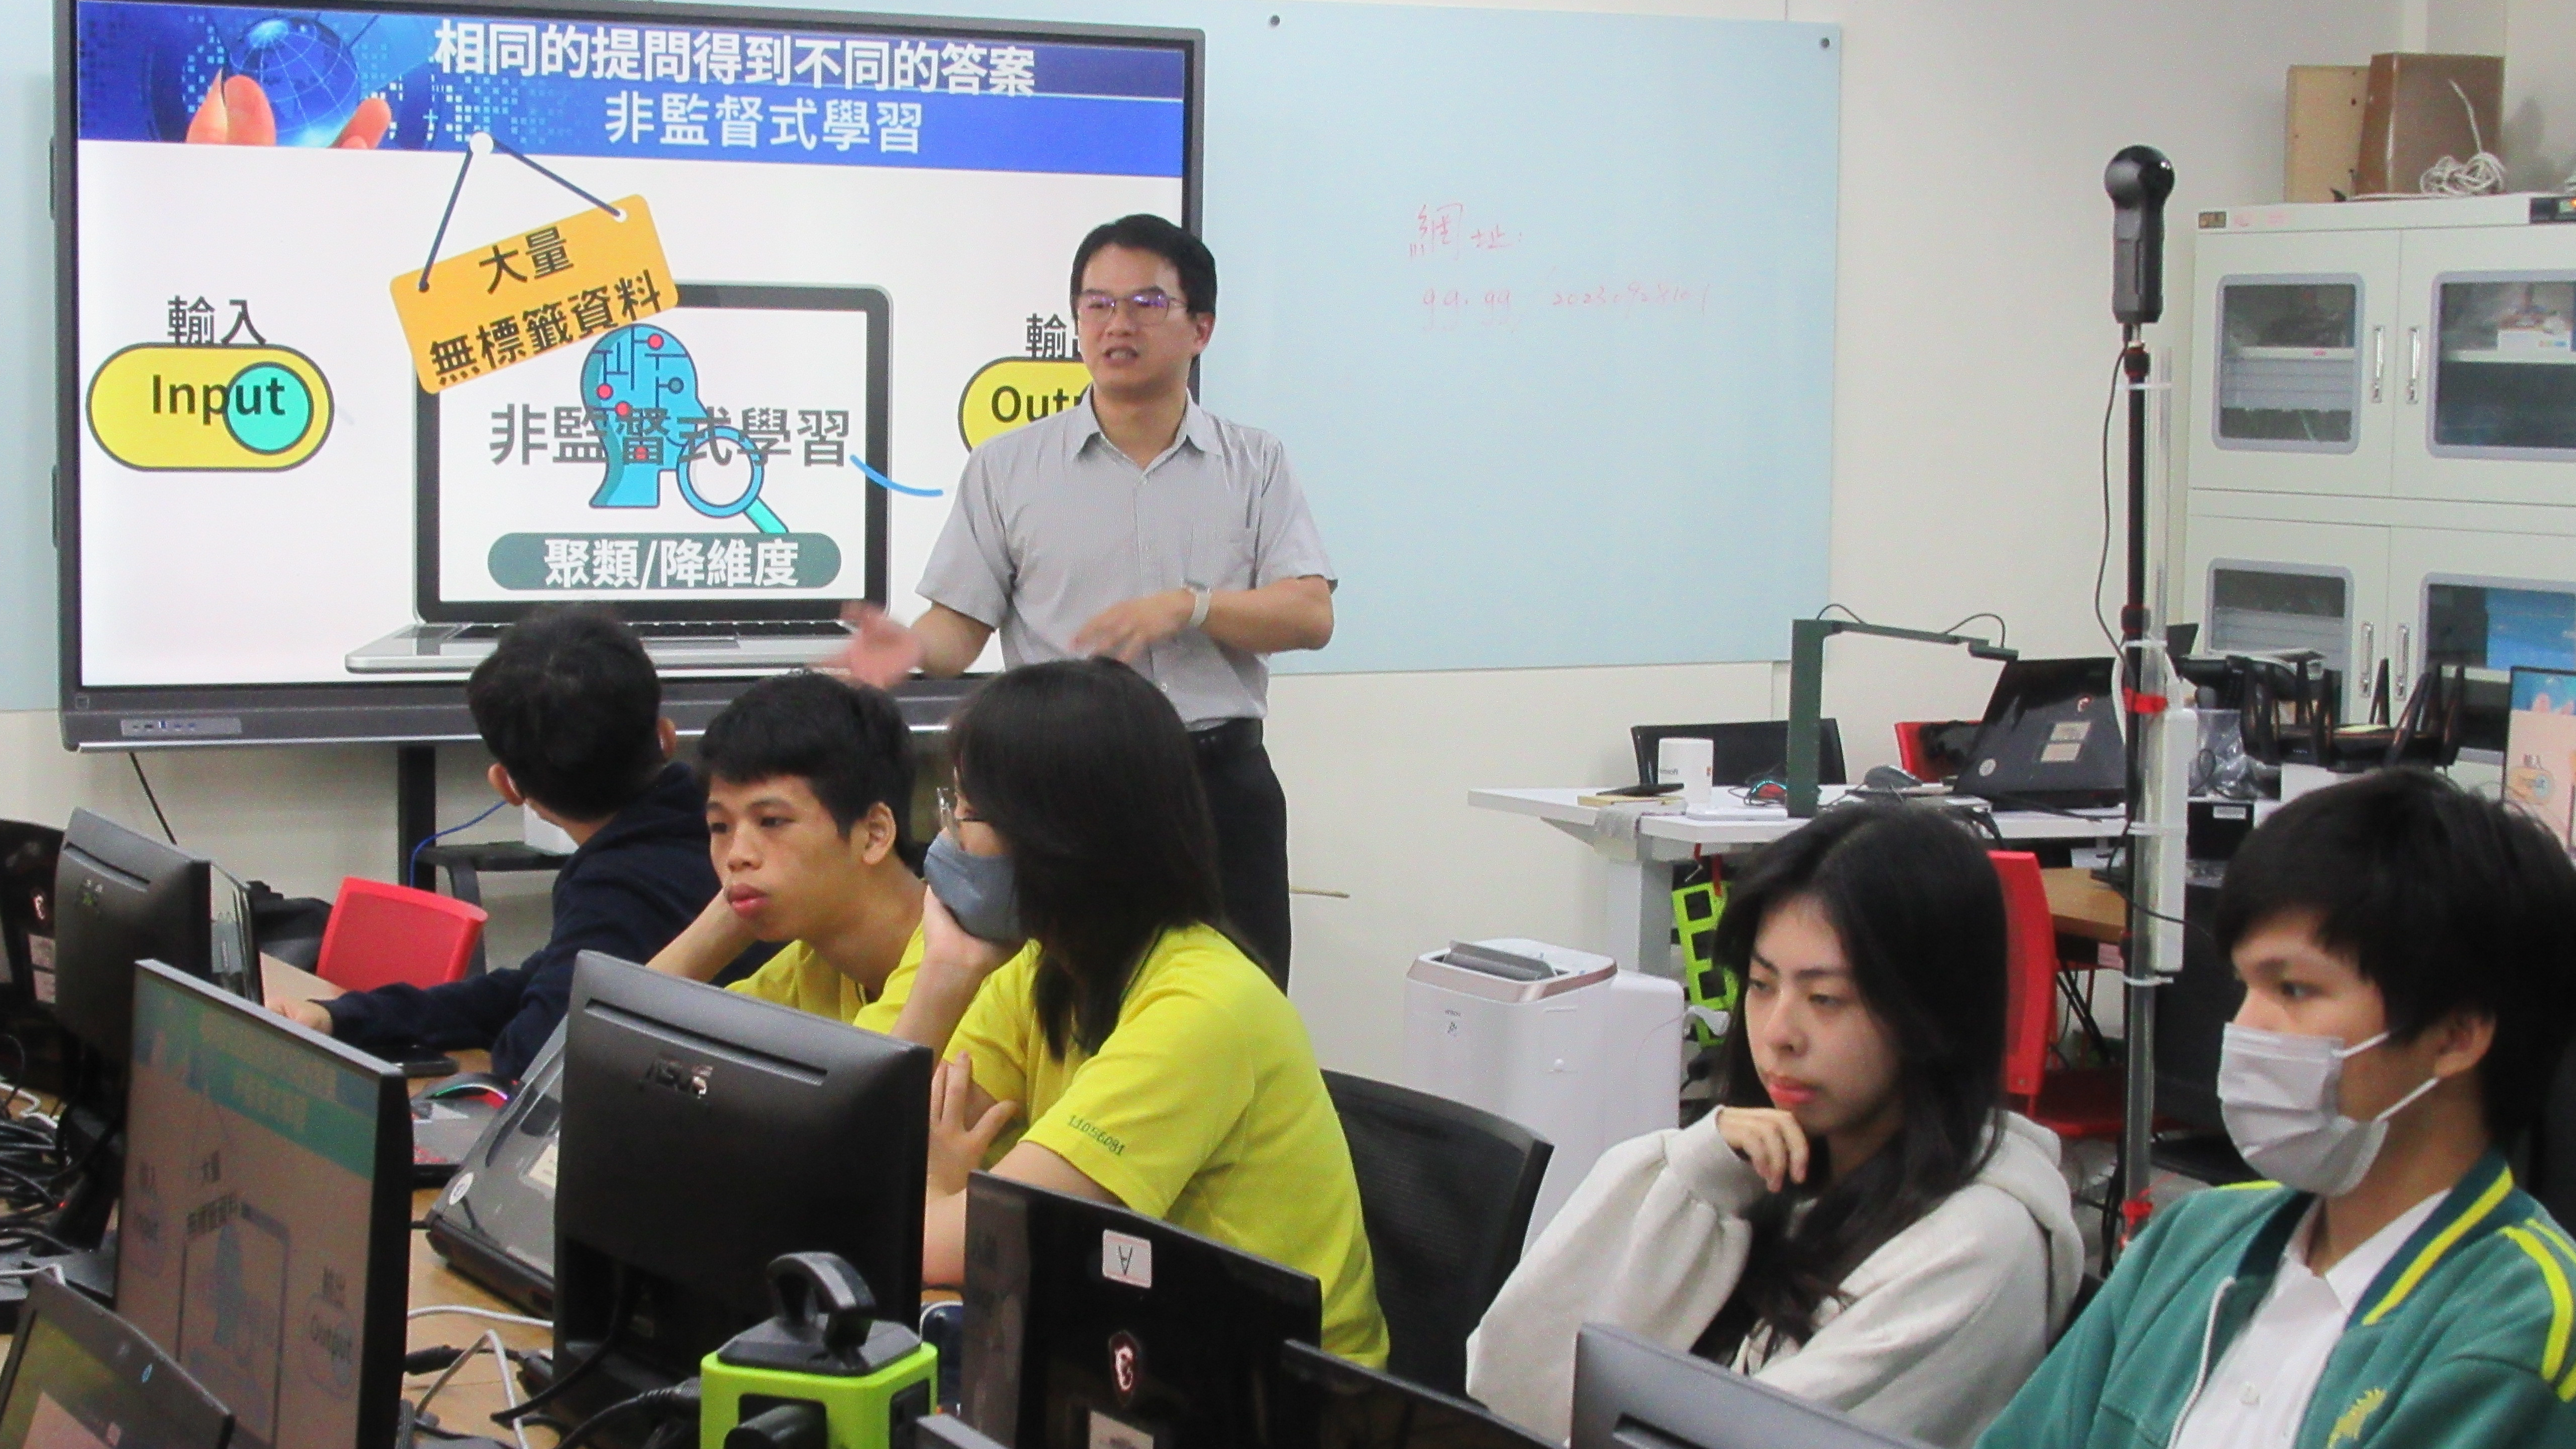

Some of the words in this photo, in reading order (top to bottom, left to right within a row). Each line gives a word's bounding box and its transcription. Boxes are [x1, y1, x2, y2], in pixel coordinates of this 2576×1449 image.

[434, 19, 1035, 97] 相同的提問得到不同的答案
[605, 91, 923, 155] 非監督式學習
[478, 226, 574, 295] 大量
[167, 295, 267, 345] 輸入
[428, 269, 662, 385] 無標籤資料
[1025, 313, 1083, 359] 輸
[152, 374, 285, 425] Input
[489, 402, 850, 466] 非監督式學習
[544, 538, 799, 590] 聚類/降維度
[1068, 1115, 1125, 1156] 11056081
